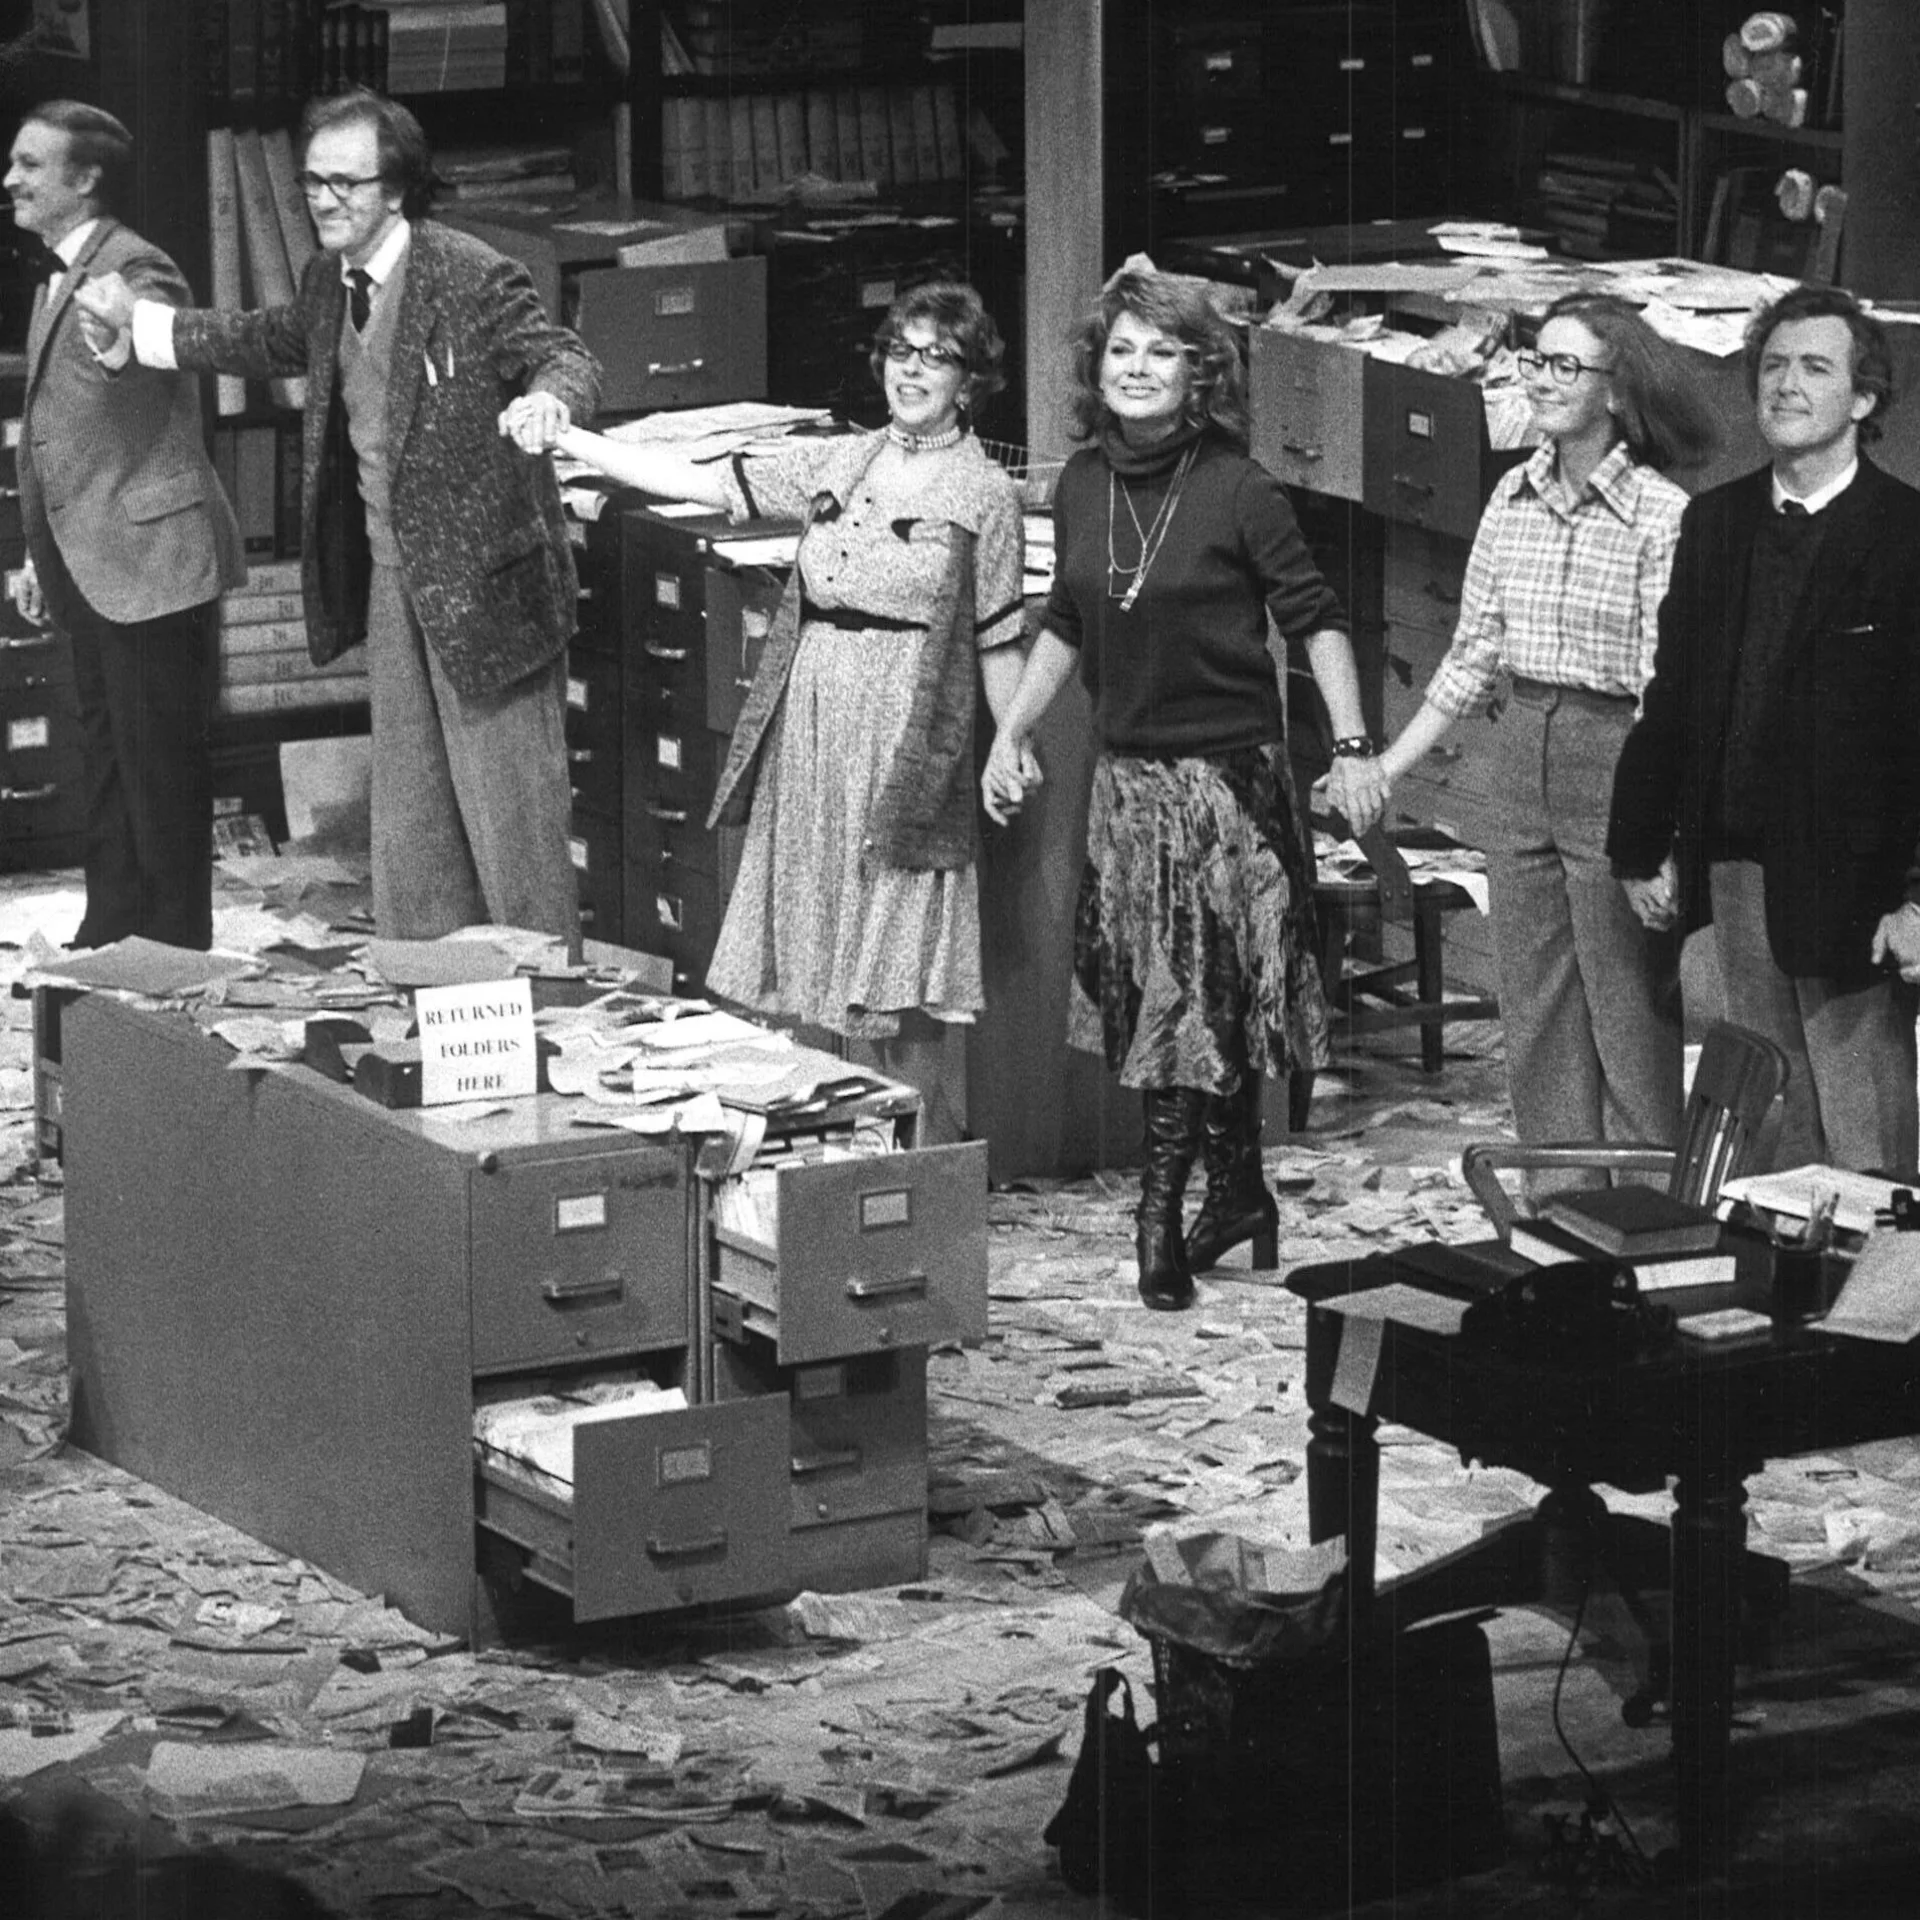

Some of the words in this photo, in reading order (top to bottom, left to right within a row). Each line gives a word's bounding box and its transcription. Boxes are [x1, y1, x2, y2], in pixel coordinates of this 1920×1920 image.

[425, 1002, 522, 1025] RETURNED
[440, 1039, 520, 1058] FOLDERS
[457, 1075, 505, 1093] HERE
